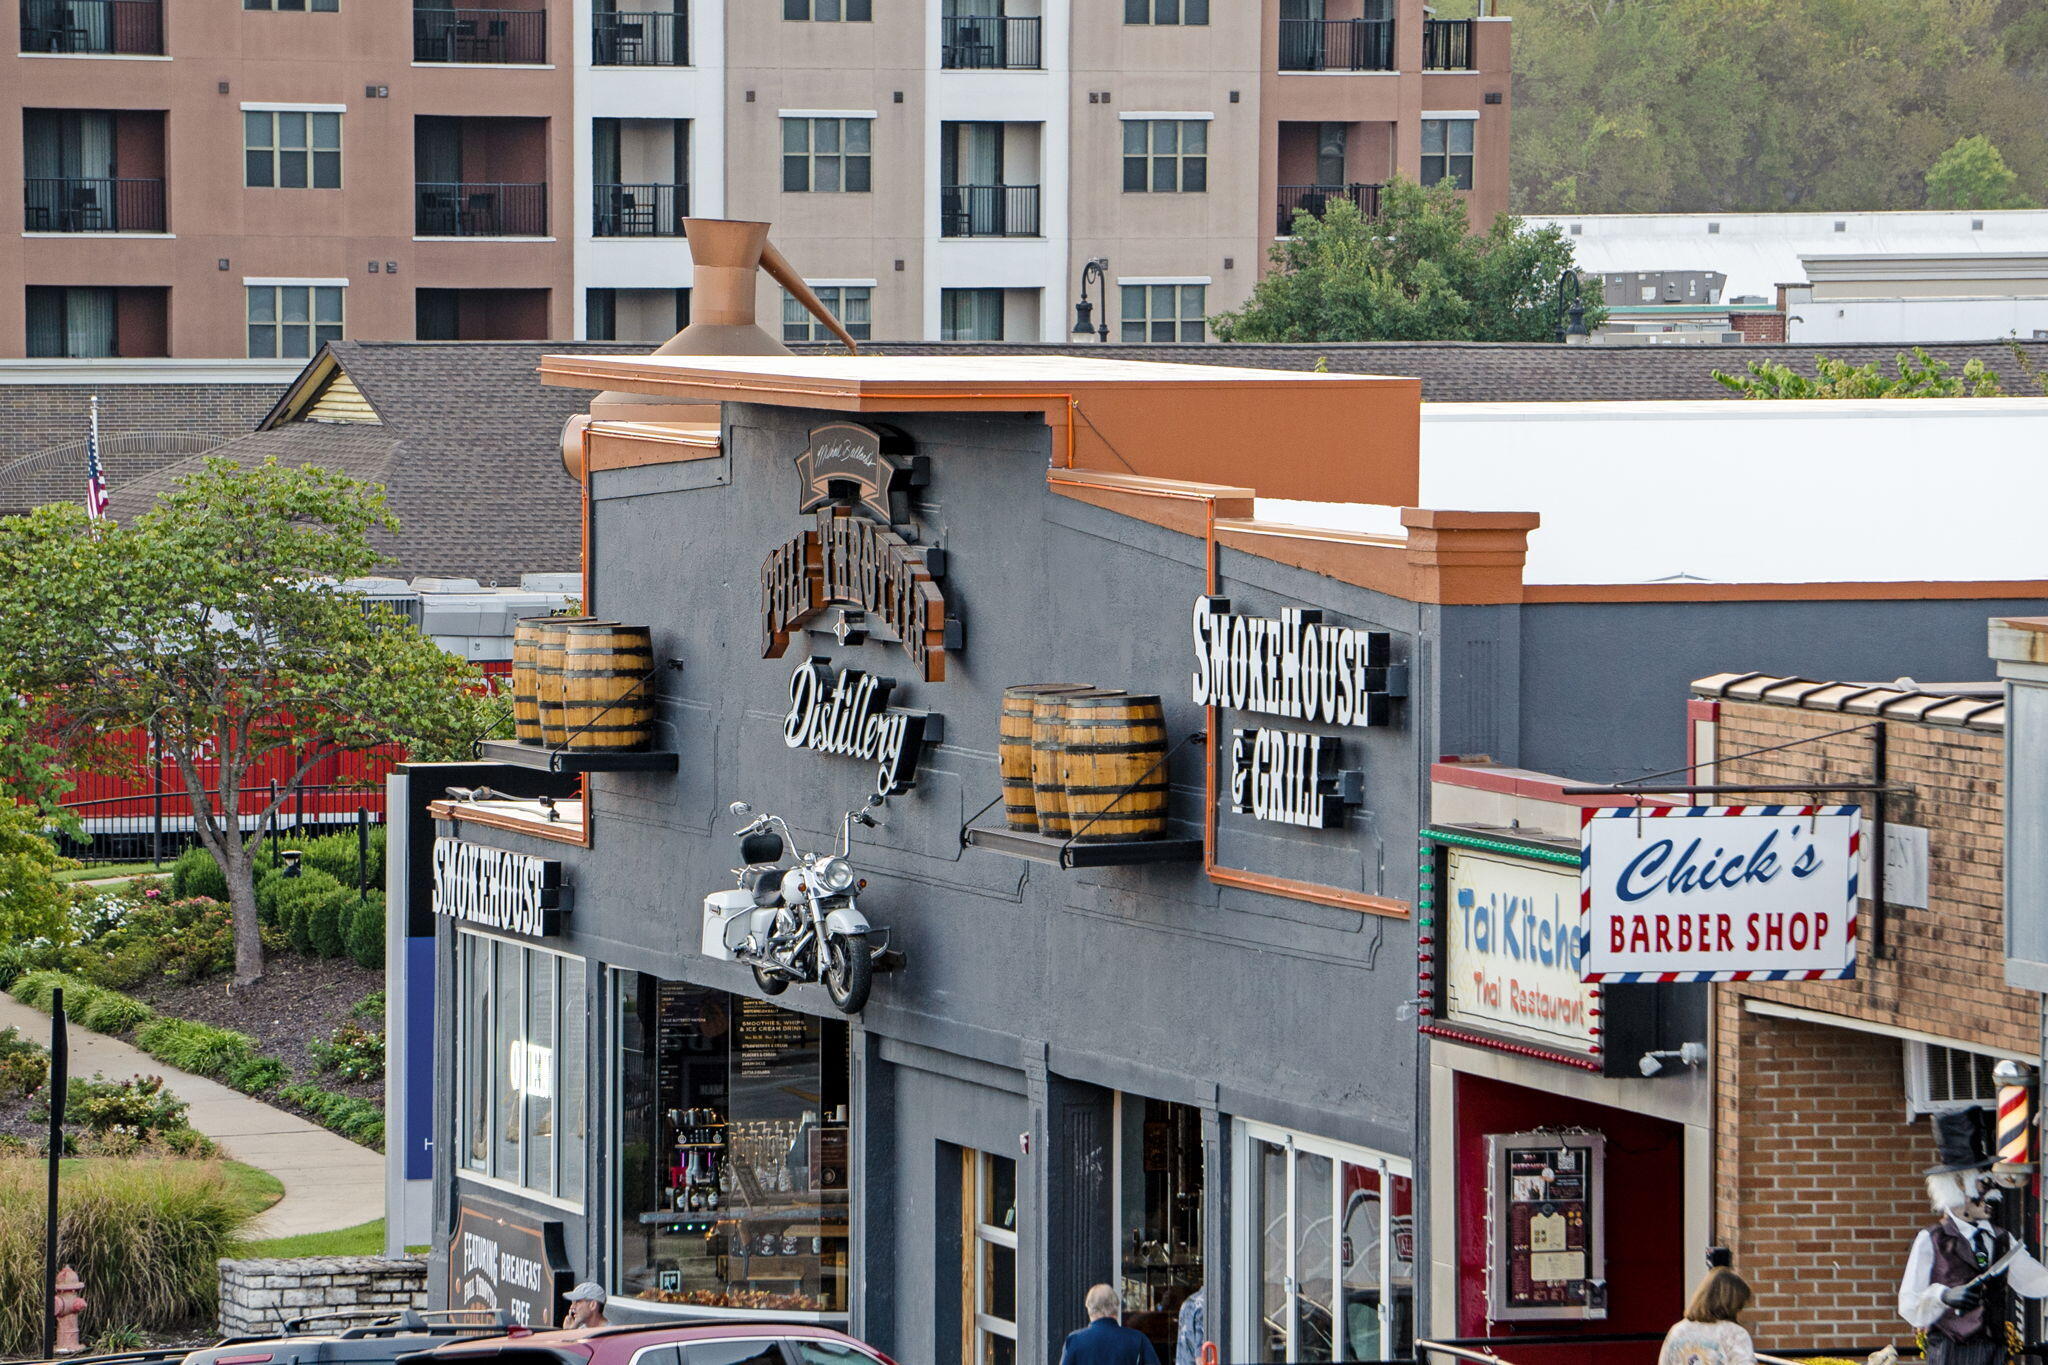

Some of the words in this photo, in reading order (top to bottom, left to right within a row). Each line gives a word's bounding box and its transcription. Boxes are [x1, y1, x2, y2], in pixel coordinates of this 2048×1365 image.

[761, 530, 810, 660] FULL
[817, 506, 929, 683] THROTTLE
[783, 656, 908, 796] Distillery
[1252, 727, 1323, 829] GRILL
[432, 837, 545, 938] SMOKEHOUSE
[1616, 824, 1823, 902] Chick's
[1458, 888, 1496, 956] Tai
[1502, 892, 1581, 973] Kitche
[1610, 914, 1735, 953] BARBER
[1746, 911, 1829, 952] SHOP
[1473, 966, 1502, 1010] Thai
[1510, 978, 1585, 1026] Restaurant
[464, 1231, 498, 1288] FEATURING
[501, 1252, 541, 1293] BREAKFAST
